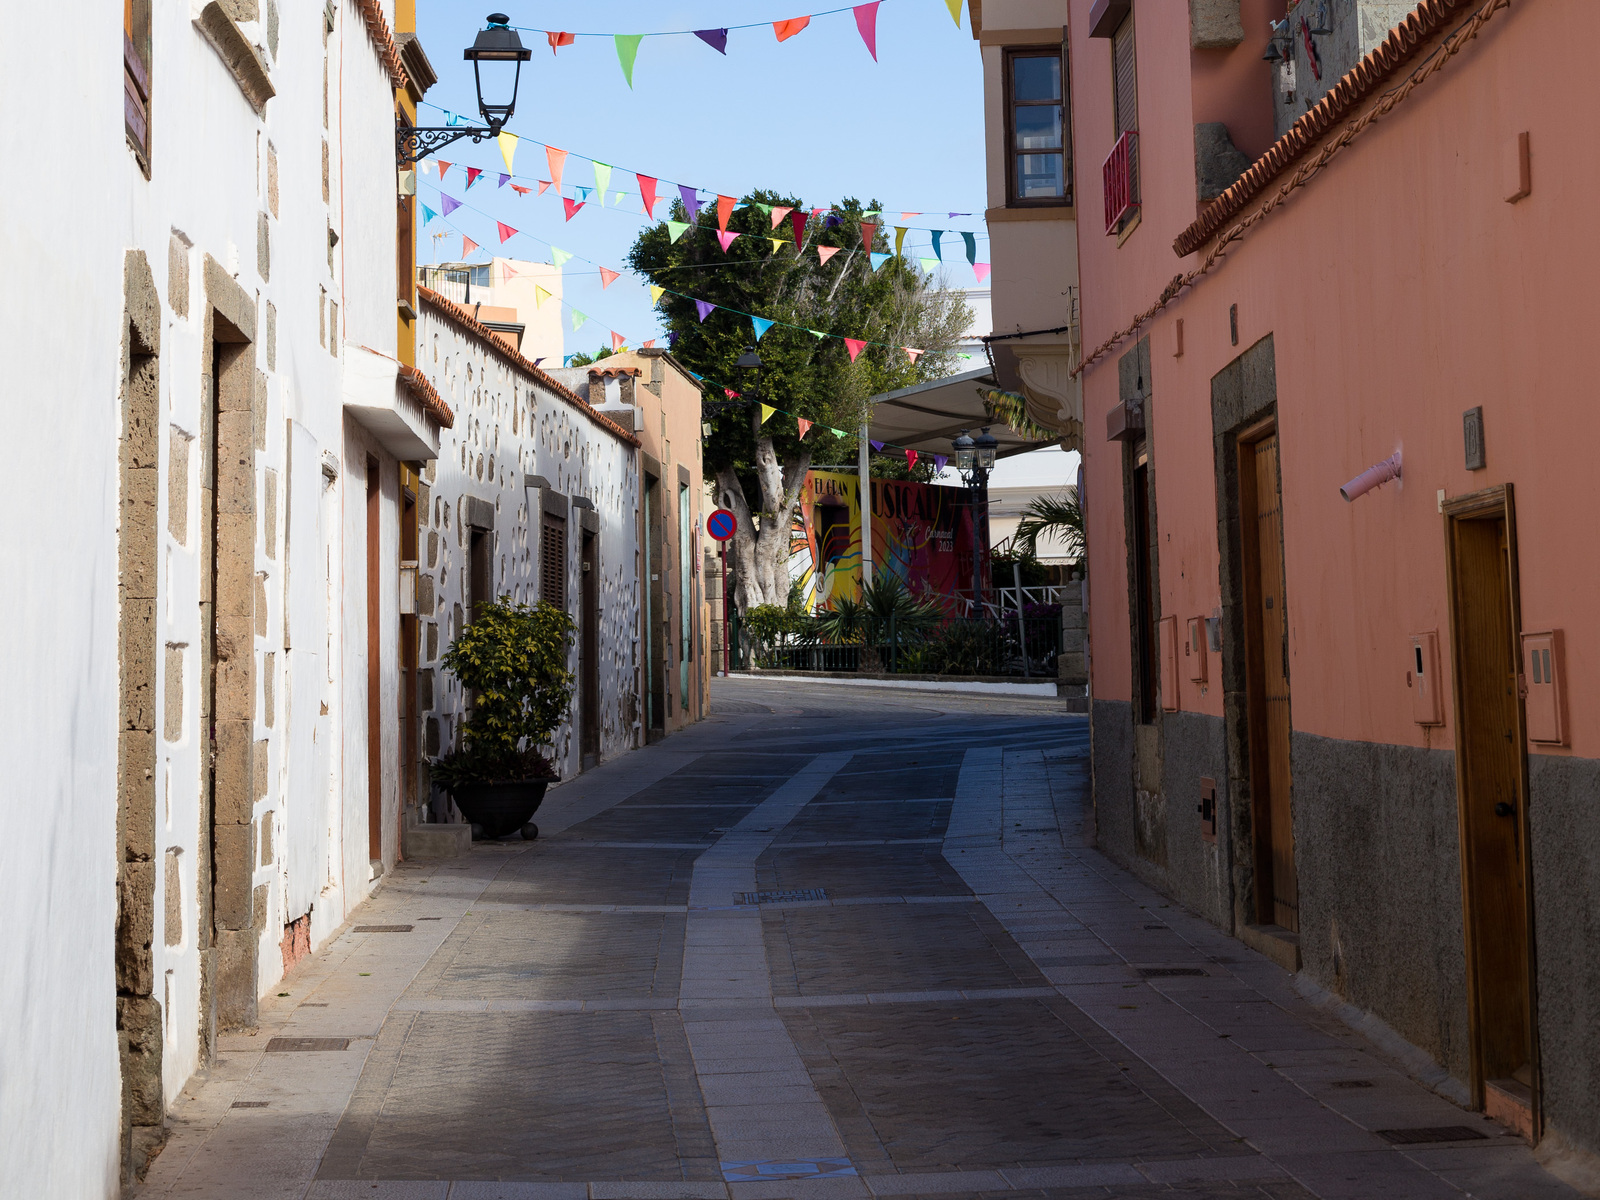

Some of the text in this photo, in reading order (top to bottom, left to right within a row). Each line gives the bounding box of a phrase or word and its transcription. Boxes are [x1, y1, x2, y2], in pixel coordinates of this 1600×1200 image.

[814, 478, 825, 495] EL
[826, 479, 848, 496] GRAN
[939, 541, 953, 552] 2023
